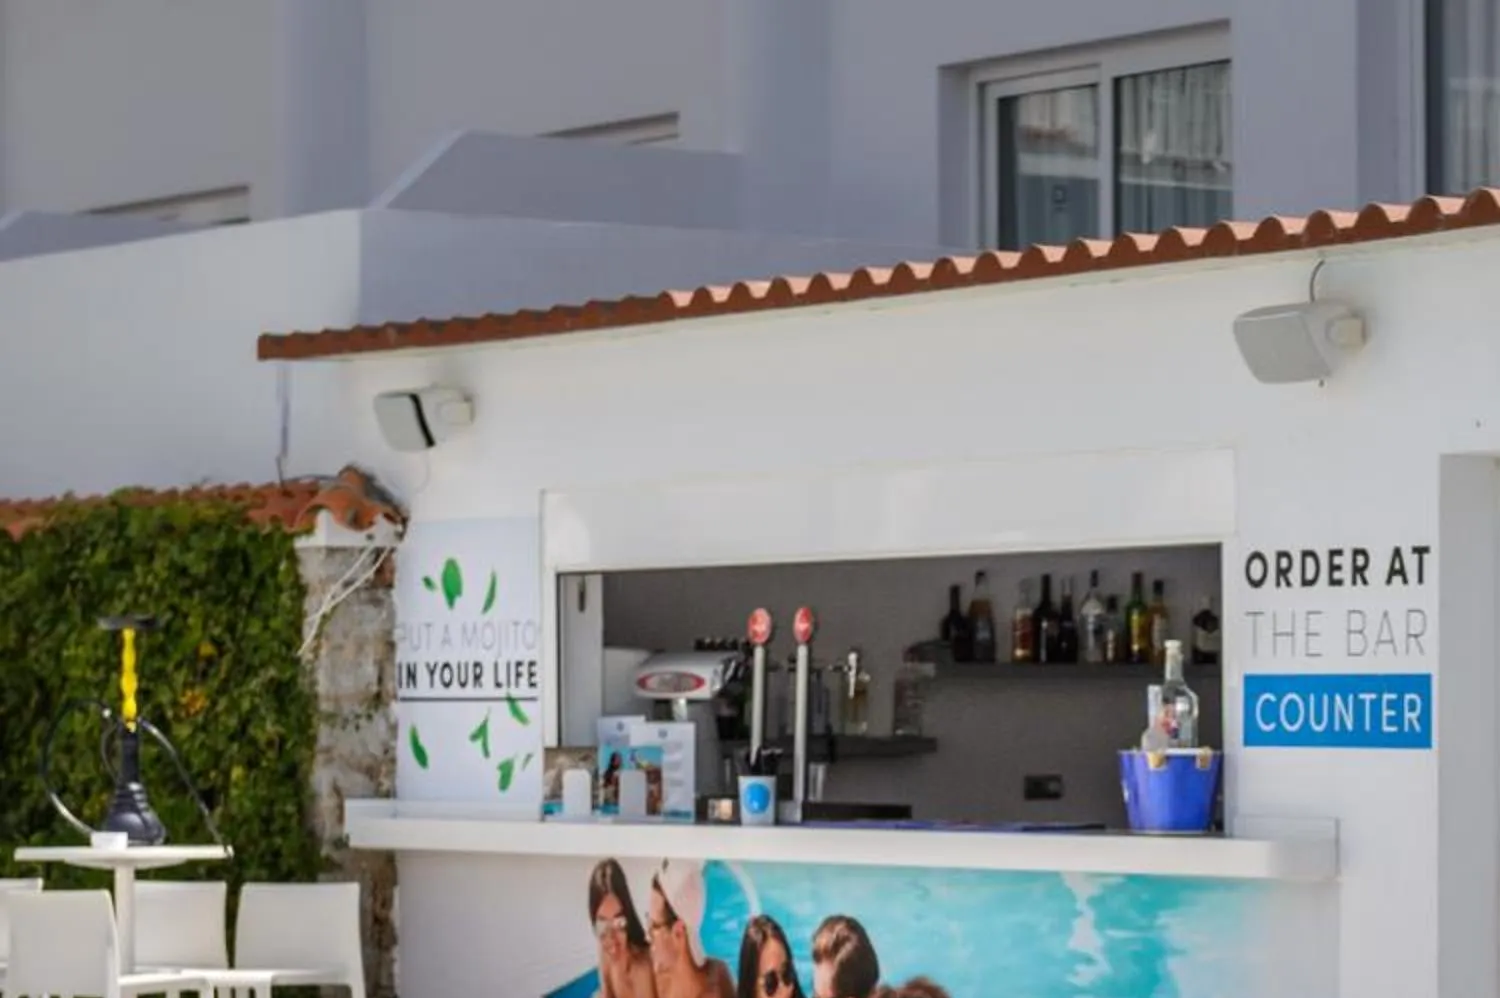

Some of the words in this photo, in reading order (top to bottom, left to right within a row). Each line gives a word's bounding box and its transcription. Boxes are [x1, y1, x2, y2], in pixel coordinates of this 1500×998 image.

[1244, 548, 1370, 589] ORDER
[1385, 546, 1431, 586] AT
[441, 623, 452, 648] A
[1244, 610, 1324, 658] THE
[1346, 609, 1428, 657] BAR
[398, 661, 418, 688] IN
[425, 661, 484, 688] YOUR
[494, 660, 538, 688] LIFE
[1255, 692, 1422, 732] COUNTER
